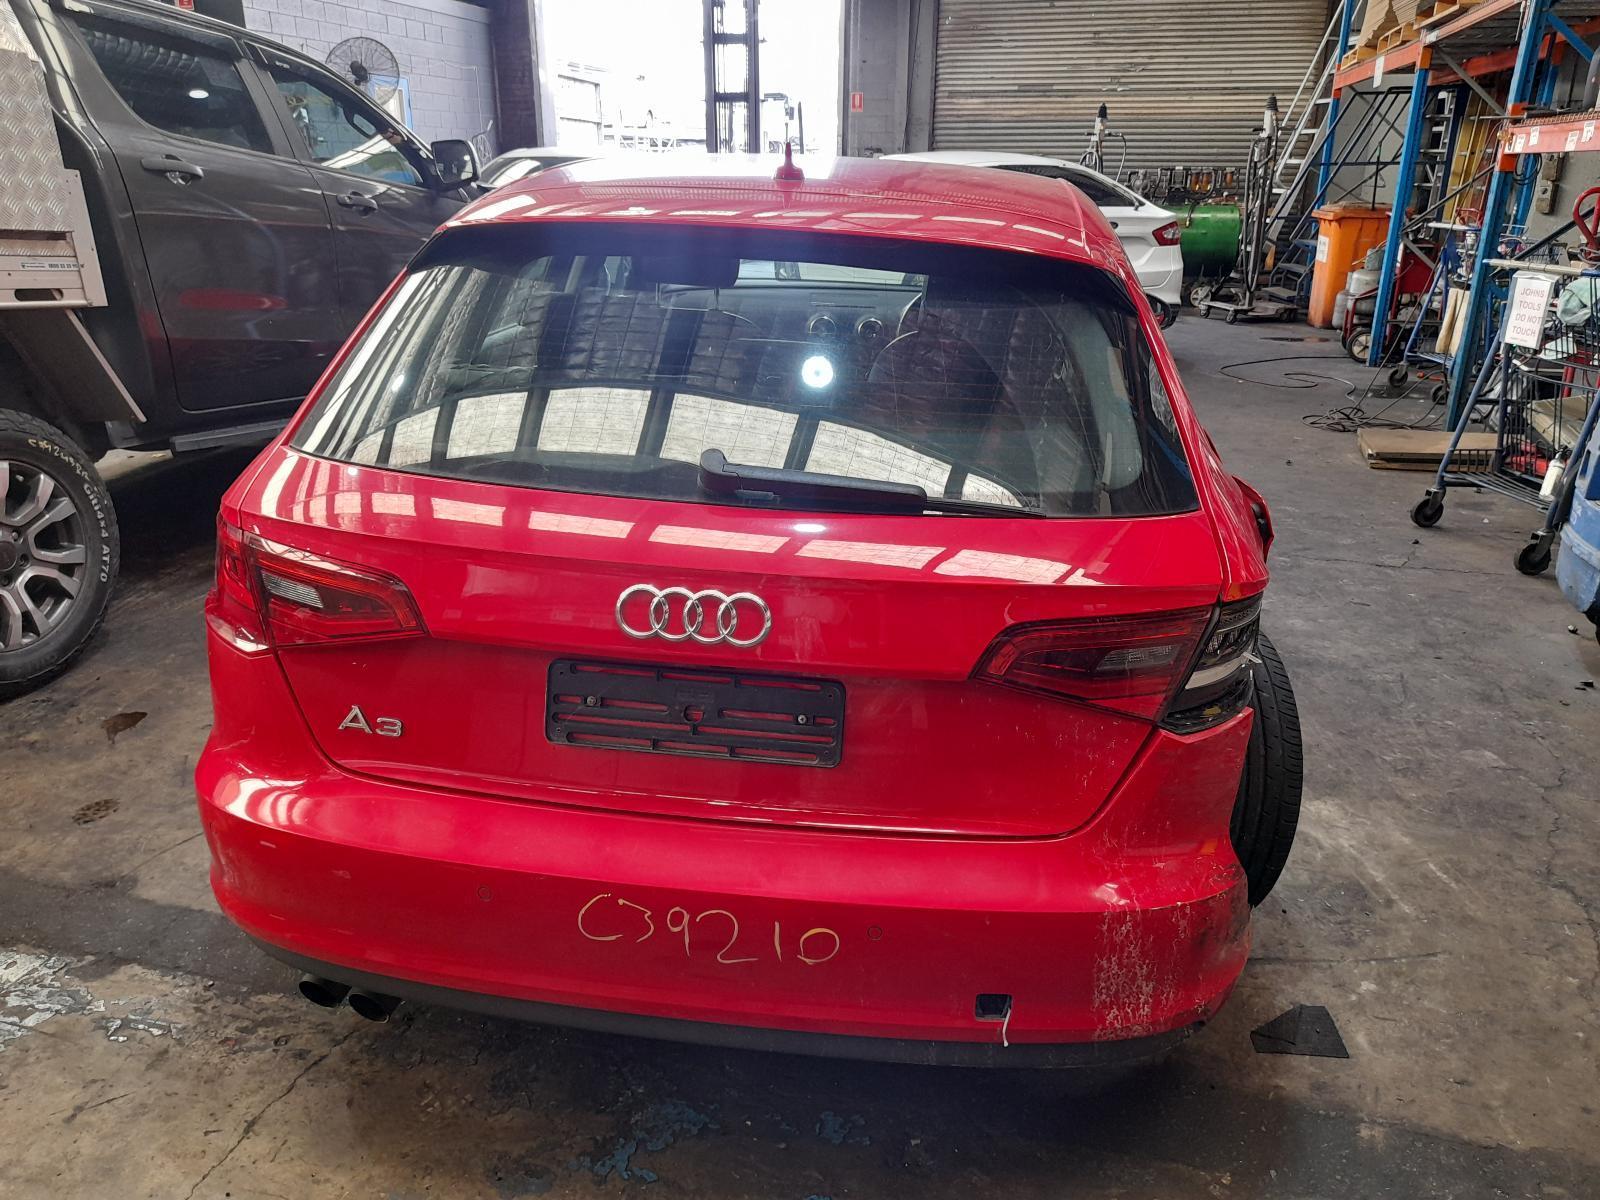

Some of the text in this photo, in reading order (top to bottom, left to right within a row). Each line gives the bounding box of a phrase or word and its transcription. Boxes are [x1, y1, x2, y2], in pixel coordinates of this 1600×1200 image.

[1520, 287, 1546, 298] JOHNS
[1519, 300, 1542, 311] TOOLS
[1515, 313, 1542, 325] DO NOT
[1512, 325, 1537, 337] TOUCH
[100, 544, 111, 583] AT70
[338, 704, 403, 738] A3
[577, 893, 840, 965] C39210
